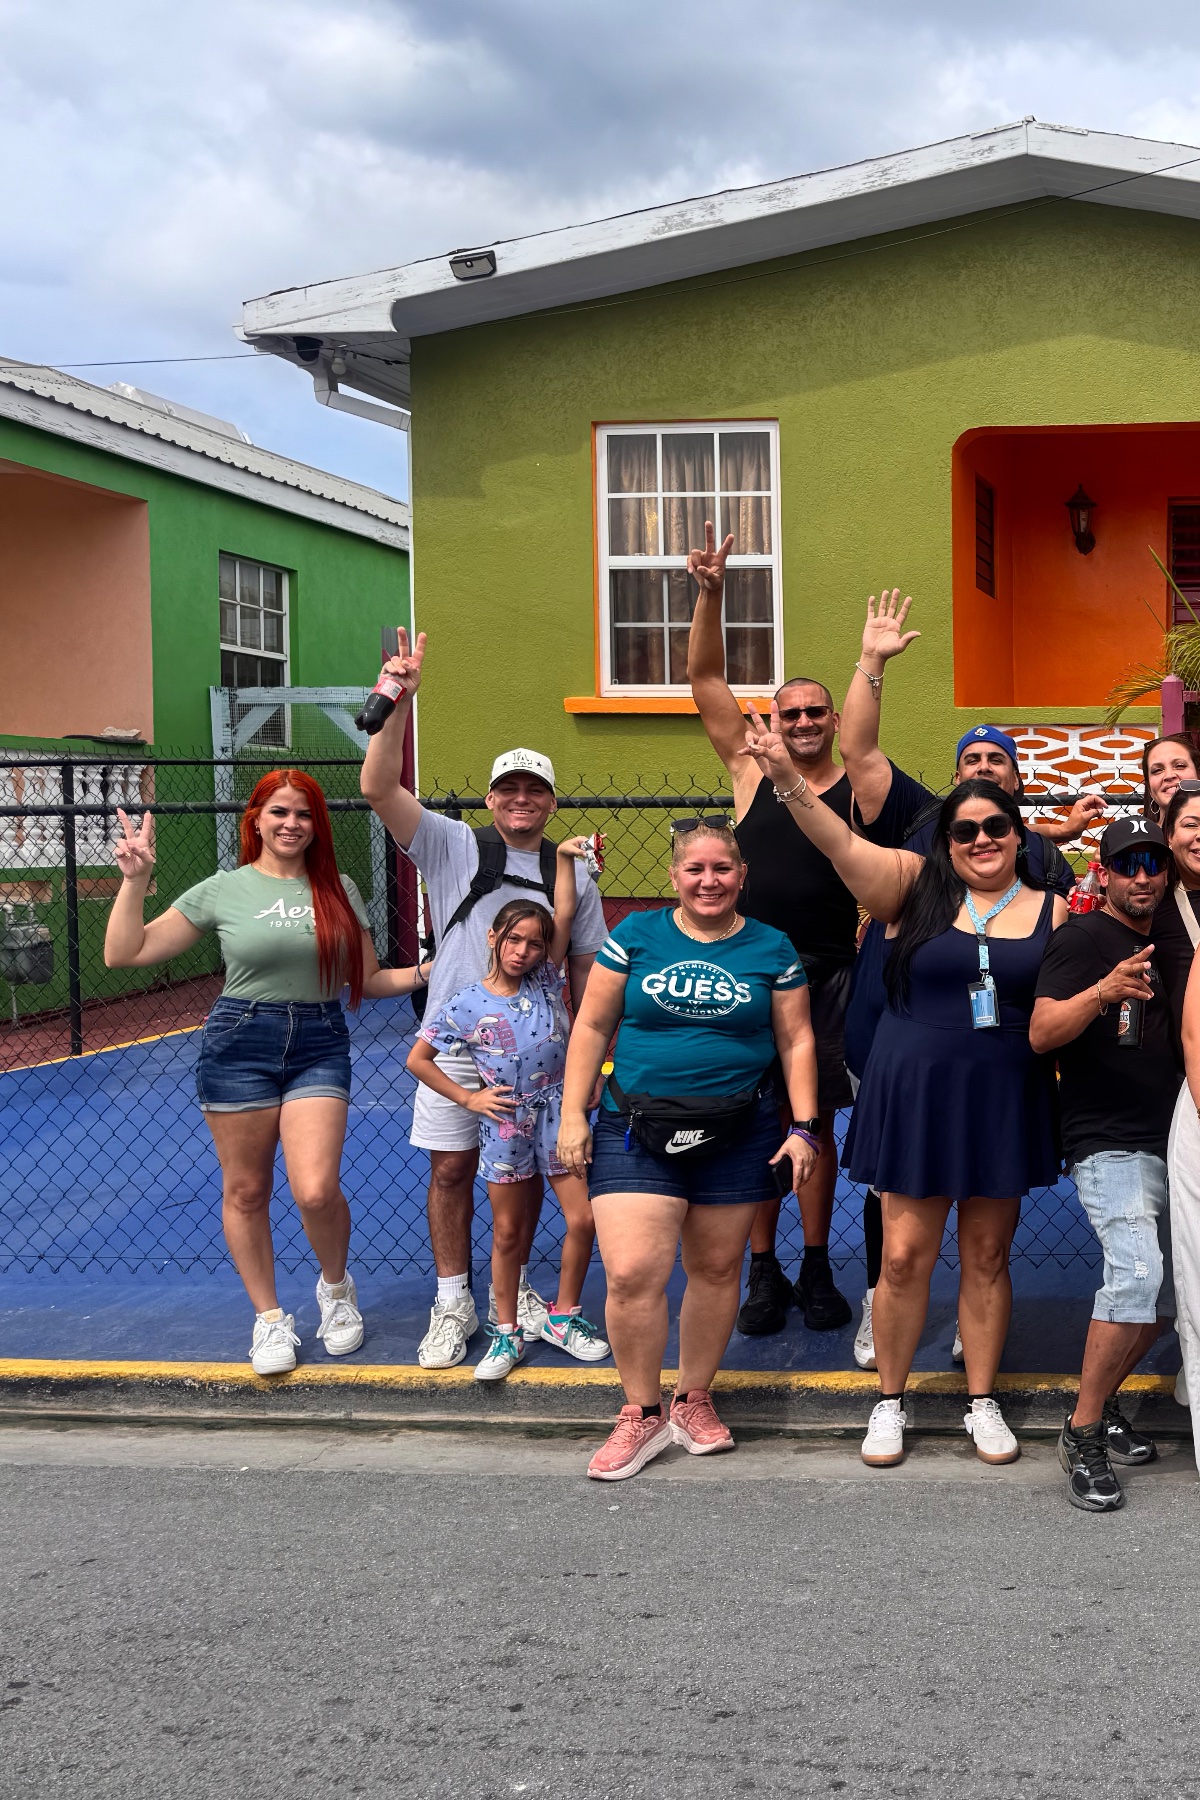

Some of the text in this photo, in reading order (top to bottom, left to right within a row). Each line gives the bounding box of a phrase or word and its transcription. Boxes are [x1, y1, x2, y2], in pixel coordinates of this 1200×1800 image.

[254, 898, 316, 919] Aer
[269, 920, 300, 928] 1987
[641, 973, 752, 1003] GUESS
[672, 1130, 704, 1144] NIKE
